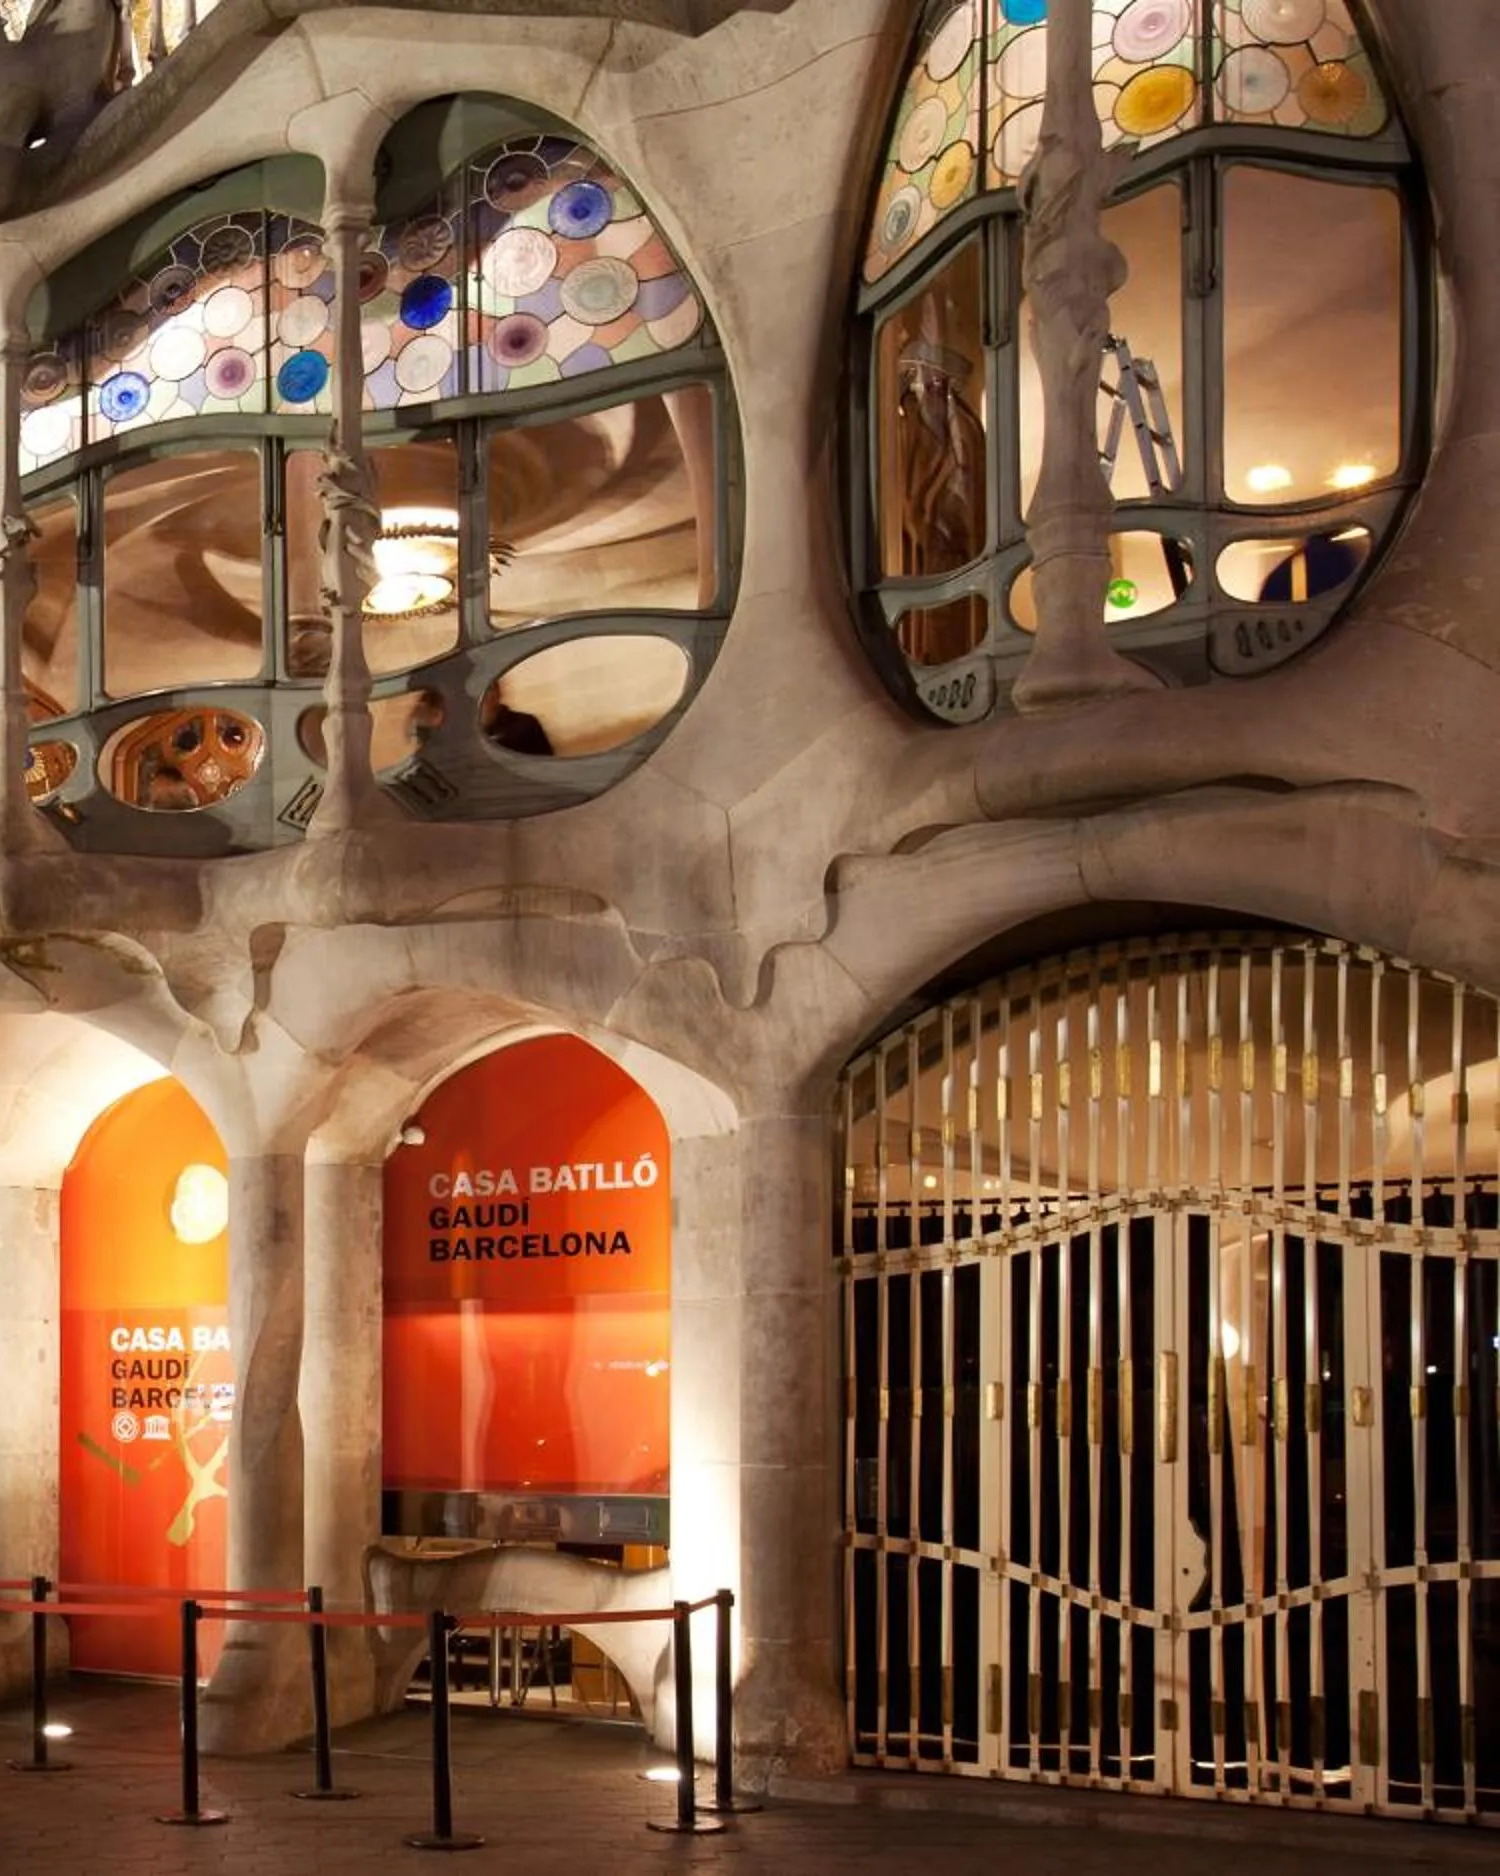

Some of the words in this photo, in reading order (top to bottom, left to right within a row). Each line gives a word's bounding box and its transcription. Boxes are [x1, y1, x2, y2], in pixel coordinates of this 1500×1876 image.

[428, 1168, 518, 1199] CASA
[529, 1152, 659, 1193] BATLLÓ
[428, 1197, 530, 1230] GAUDÍ
[428, 1231, 632, 1262] BARCELONA
[109, 1326, 184, 1353] CASA
[110, 1352, 191, 1381] GAUDÍ
